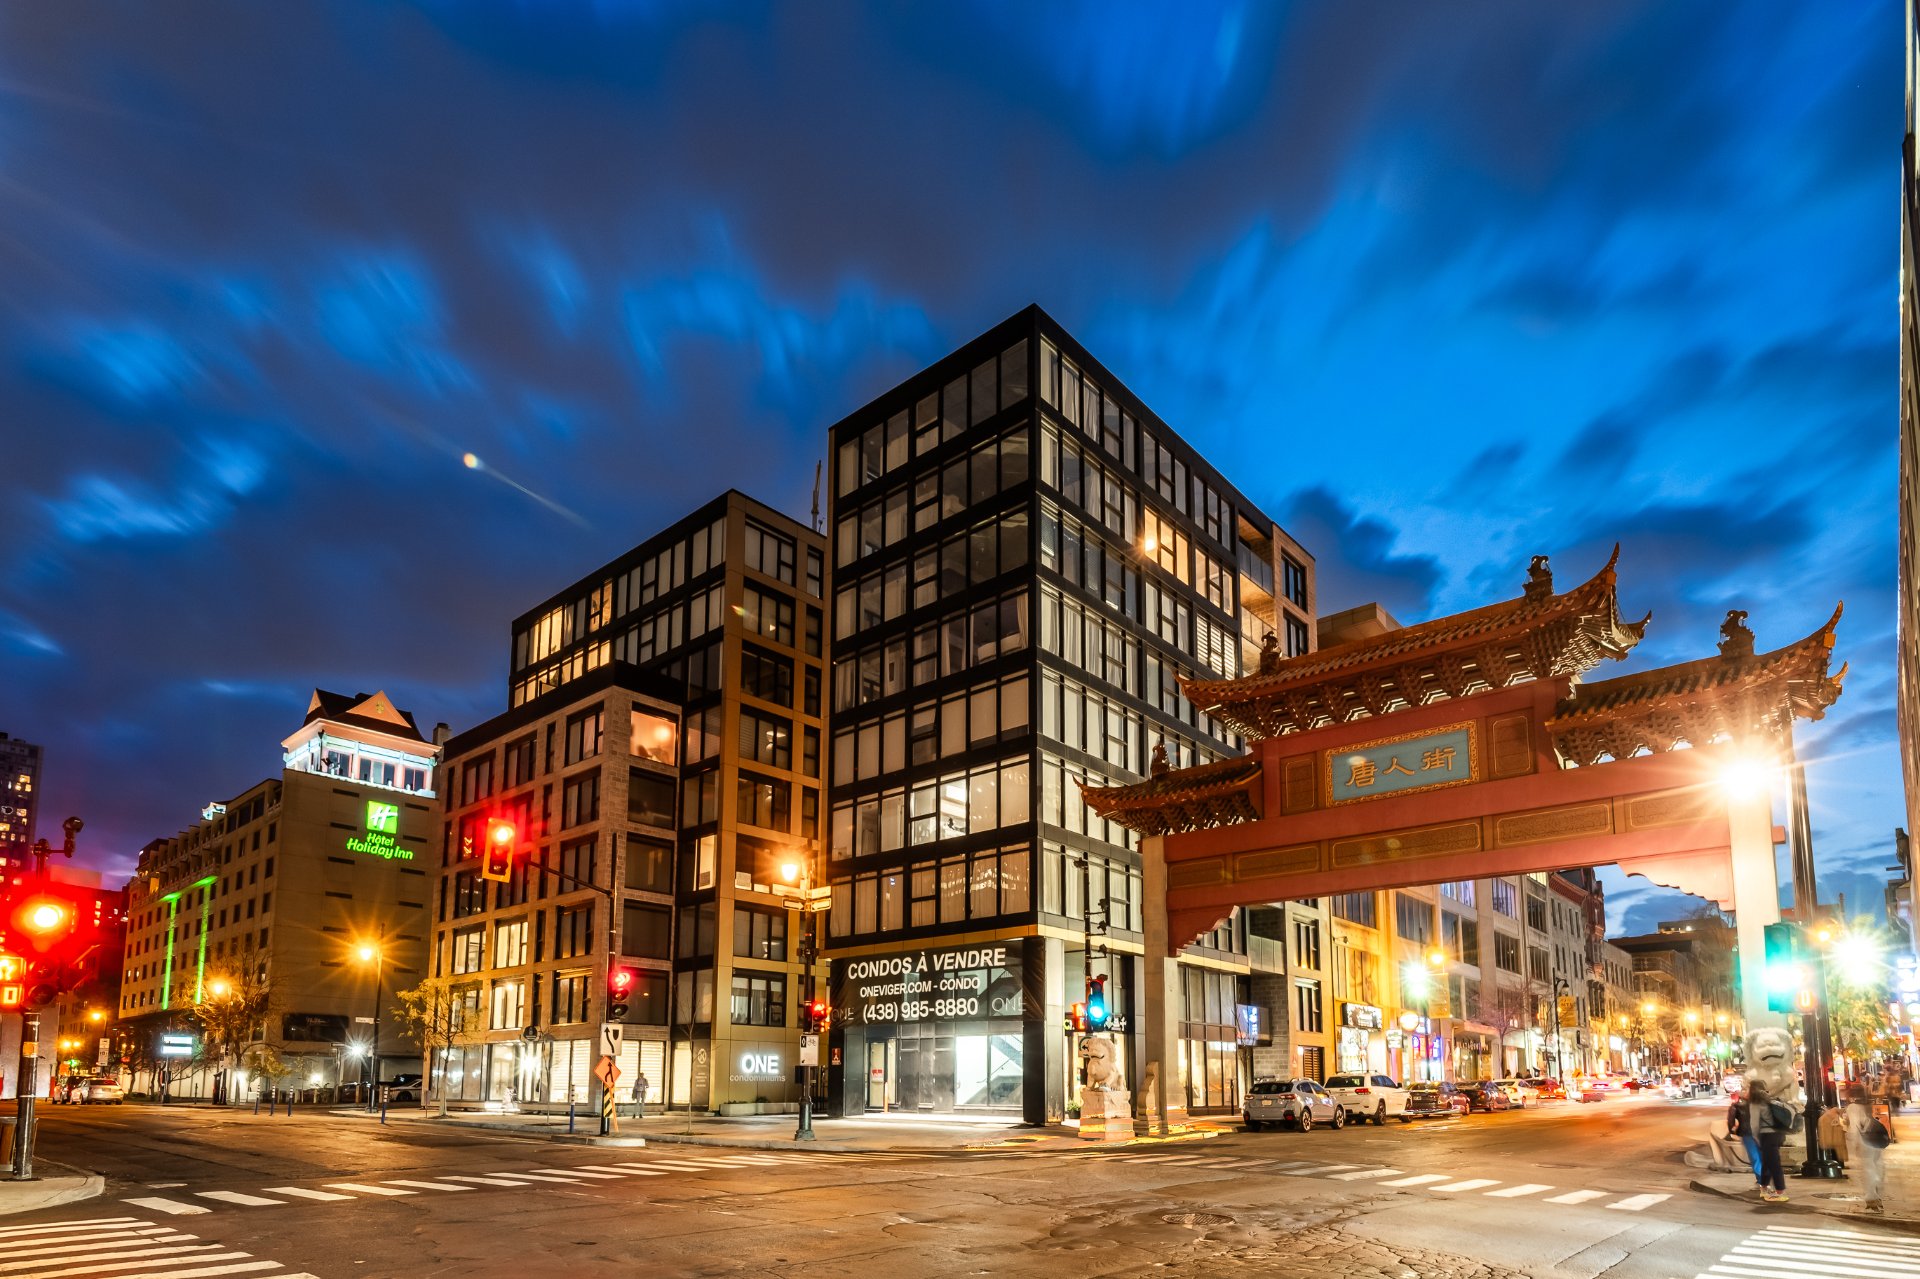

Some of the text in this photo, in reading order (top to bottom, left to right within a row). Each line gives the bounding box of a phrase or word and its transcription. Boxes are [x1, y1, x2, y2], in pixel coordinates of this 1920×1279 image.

[1344, 747, 1457, 788] 唐人街
[346, 838, 414, 860] Holiday Inn
[366, 832, 394, 846] Hôtel
[848, 948, 1006, 980] CONDOS À VENDRE
[860, 980, 932, 998] ONEVIGER.COM
[939, 977, 981, 991] CONDO
[863, 998, 979, 1024] (438) 985-8880
[992, 997, 1028, 1011] ONE
[741, 1054, 780, 1073] ONE
[729, 1074, 786, 1082] condominiums
